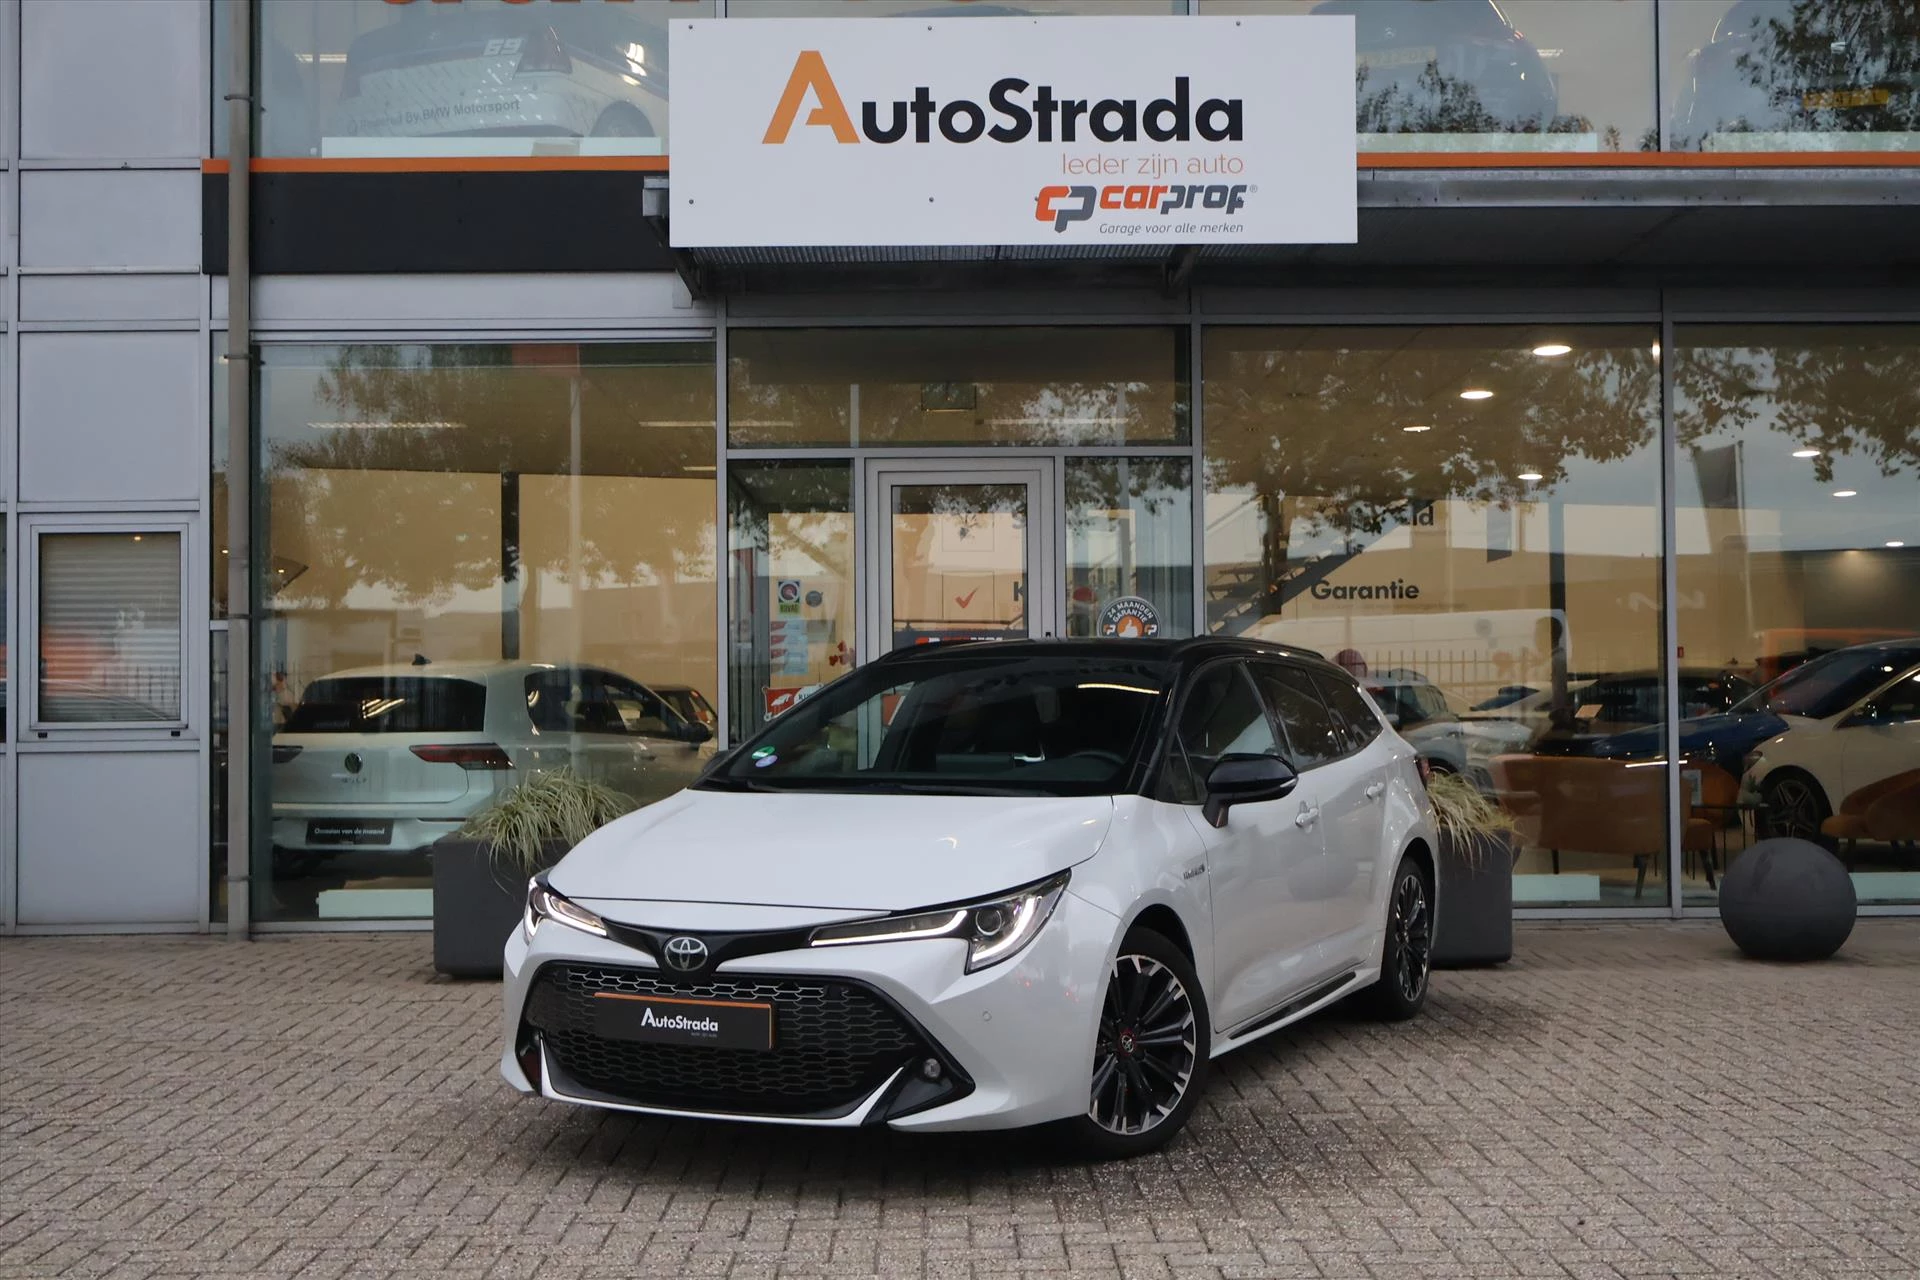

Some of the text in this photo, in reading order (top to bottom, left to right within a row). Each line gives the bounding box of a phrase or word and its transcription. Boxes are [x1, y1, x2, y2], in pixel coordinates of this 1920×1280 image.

[762, 50, 1243, 144] AutoStrada
[422, 108, 450, 120] BMW
[454, 100, 521, 116] Motorsport
[1062, 153, 1244, 180] Ieder zijn auto
[1099, 222, 1244, 236] Garage voor alle merken
[1311, 578, 1420, 600] Garantie
[1112, 608, 1148, 623] GARANTIE
[1116, 601, 1154, 619] MAANDEN
[641, 1007, 719, 1032] AutoStrada
